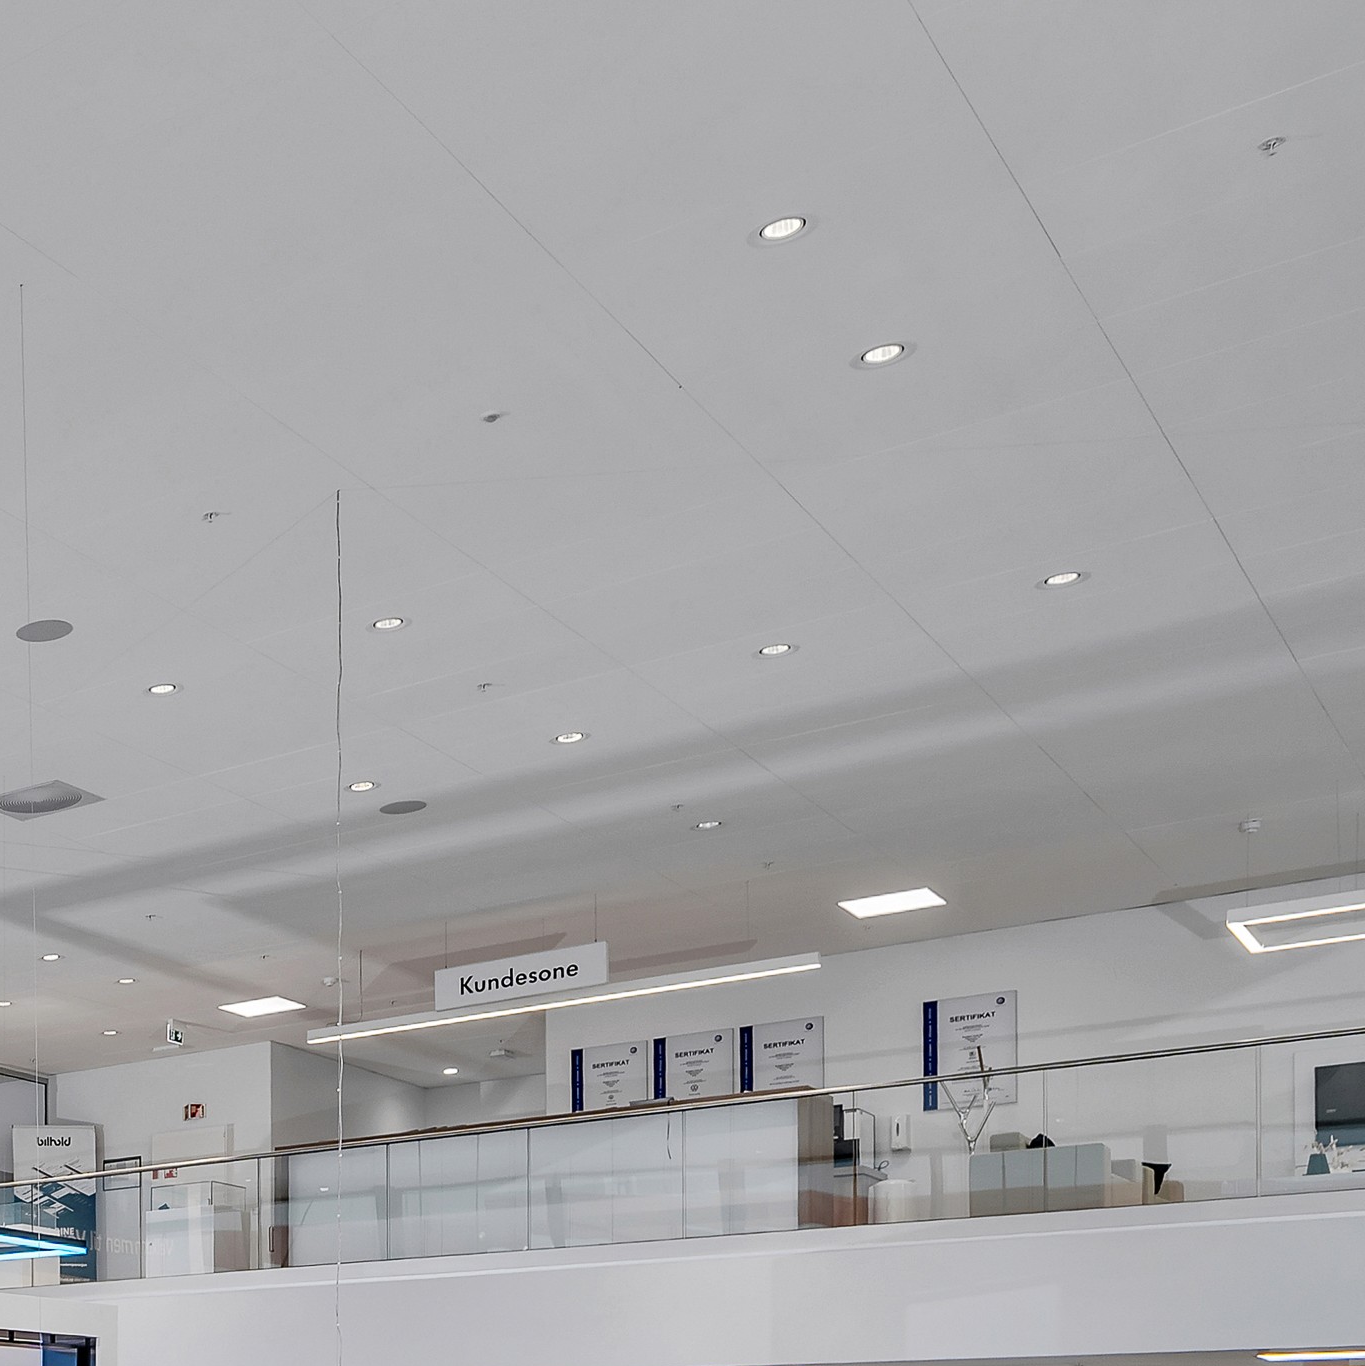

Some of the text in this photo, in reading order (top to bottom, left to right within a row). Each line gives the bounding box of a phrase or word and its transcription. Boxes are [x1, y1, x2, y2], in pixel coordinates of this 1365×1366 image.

[460, 963, 579, 995] Kundesone
[949, 1010, 996, 1023] SERTIFIKAT
[763, 1038, 806, 1050] SERTIFIKAT
[674, 1047, 715, 1059] SERTIFIKAT
[592, 1059, 630, 1070] SERTIFIKAT
